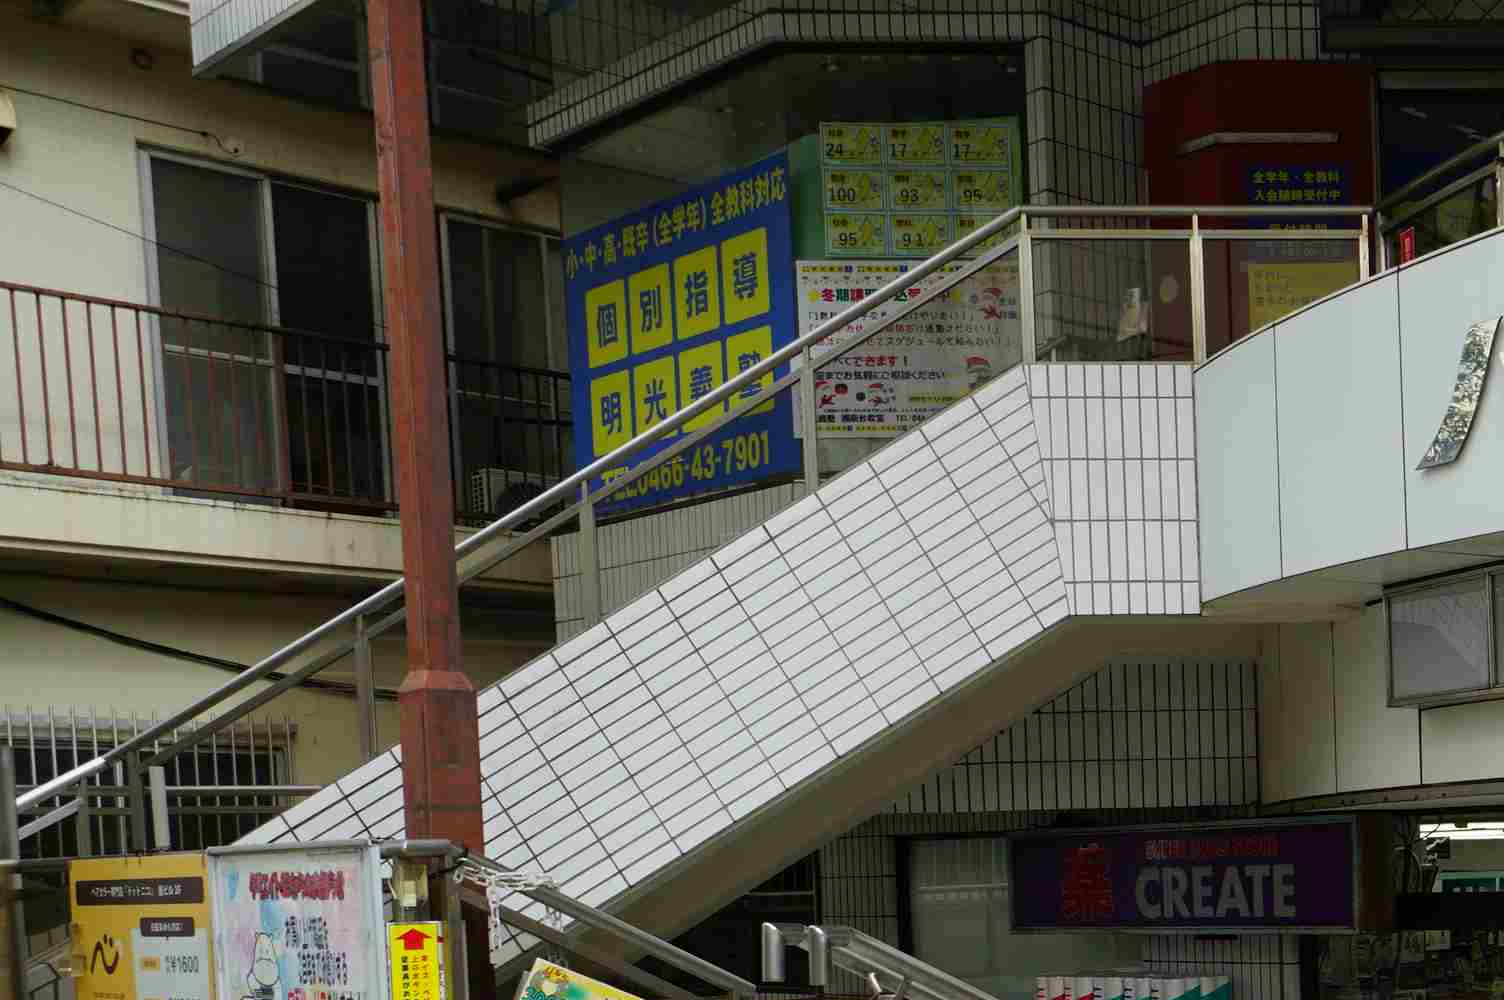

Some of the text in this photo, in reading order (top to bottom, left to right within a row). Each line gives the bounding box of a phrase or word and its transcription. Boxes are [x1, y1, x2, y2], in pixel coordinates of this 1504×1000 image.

[596, 250, 760, 350] 個別指導
[1134, 863, 1298, 920] CREATE
